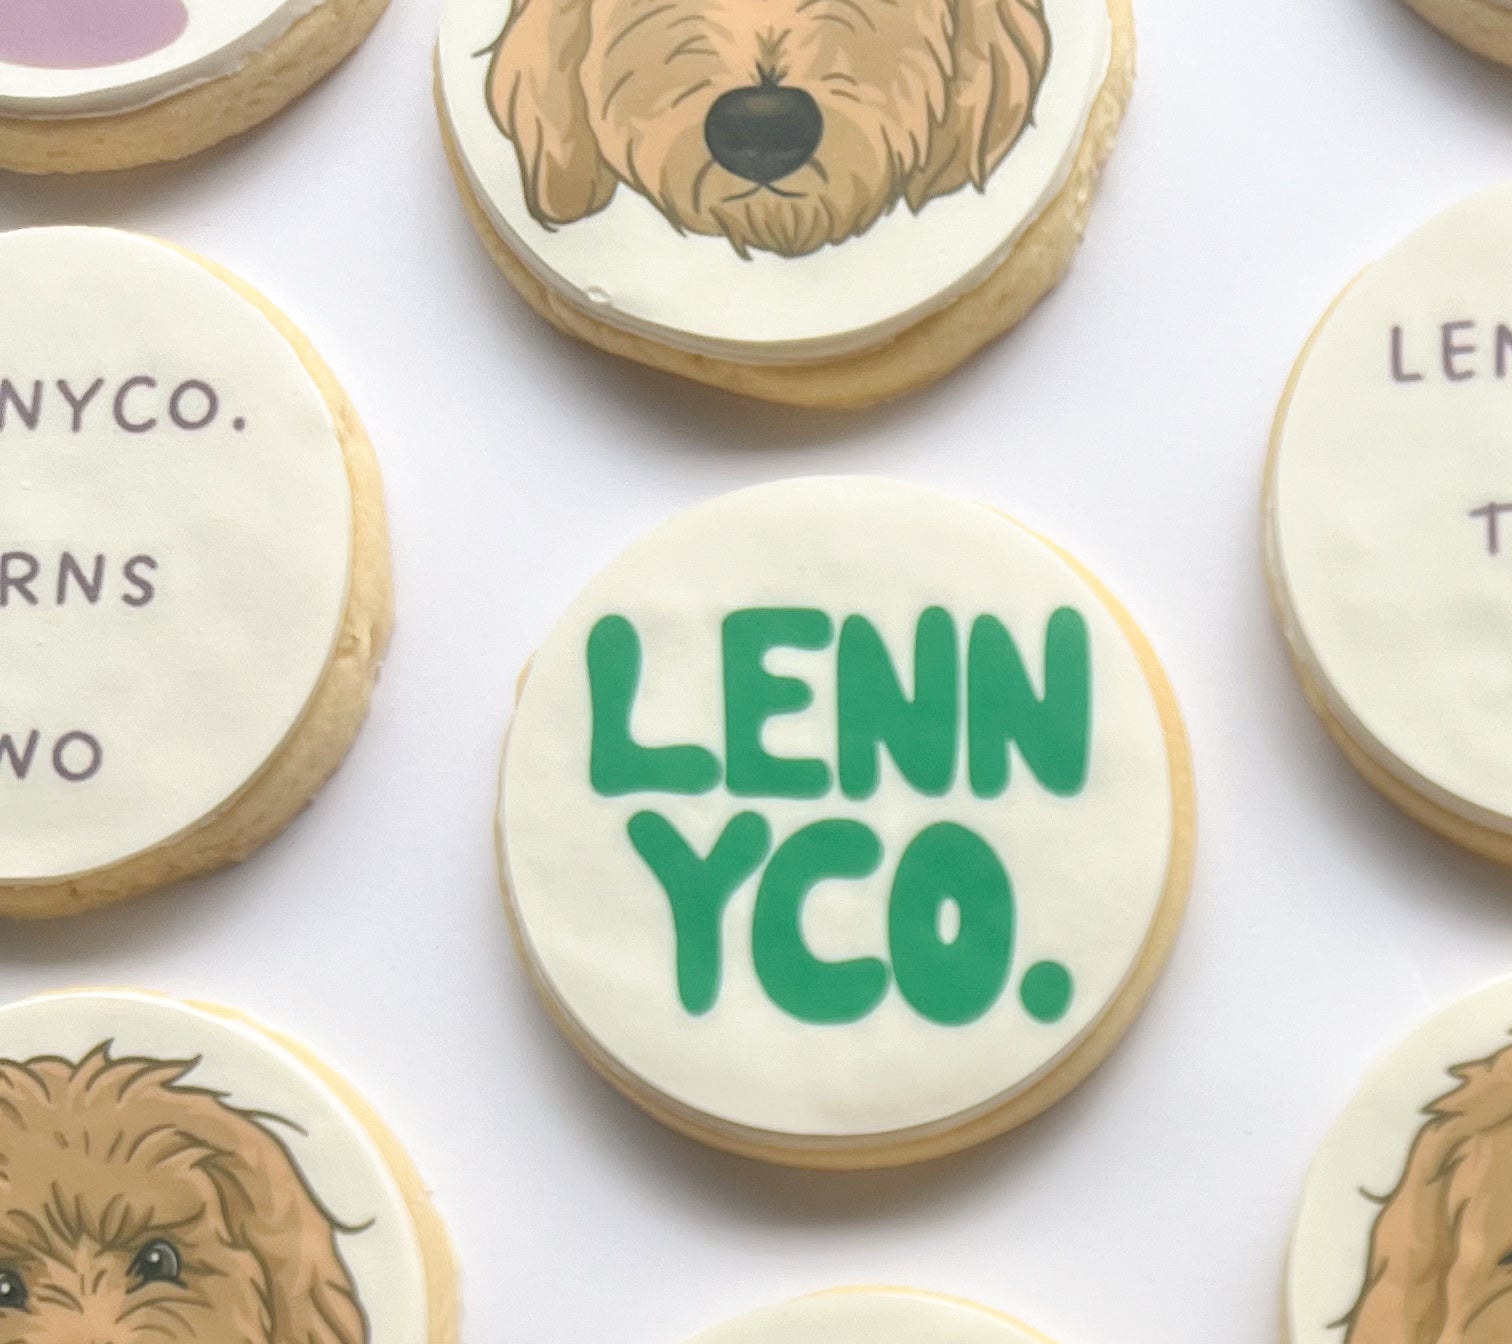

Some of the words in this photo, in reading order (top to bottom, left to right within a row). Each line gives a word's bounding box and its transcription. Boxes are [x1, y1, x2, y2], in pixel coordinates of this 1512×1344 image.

[0, 550, 158, 608] RNS
[587, 607, 1090, 798] LENN
[628, 811, 1071, 1024] YCO.
